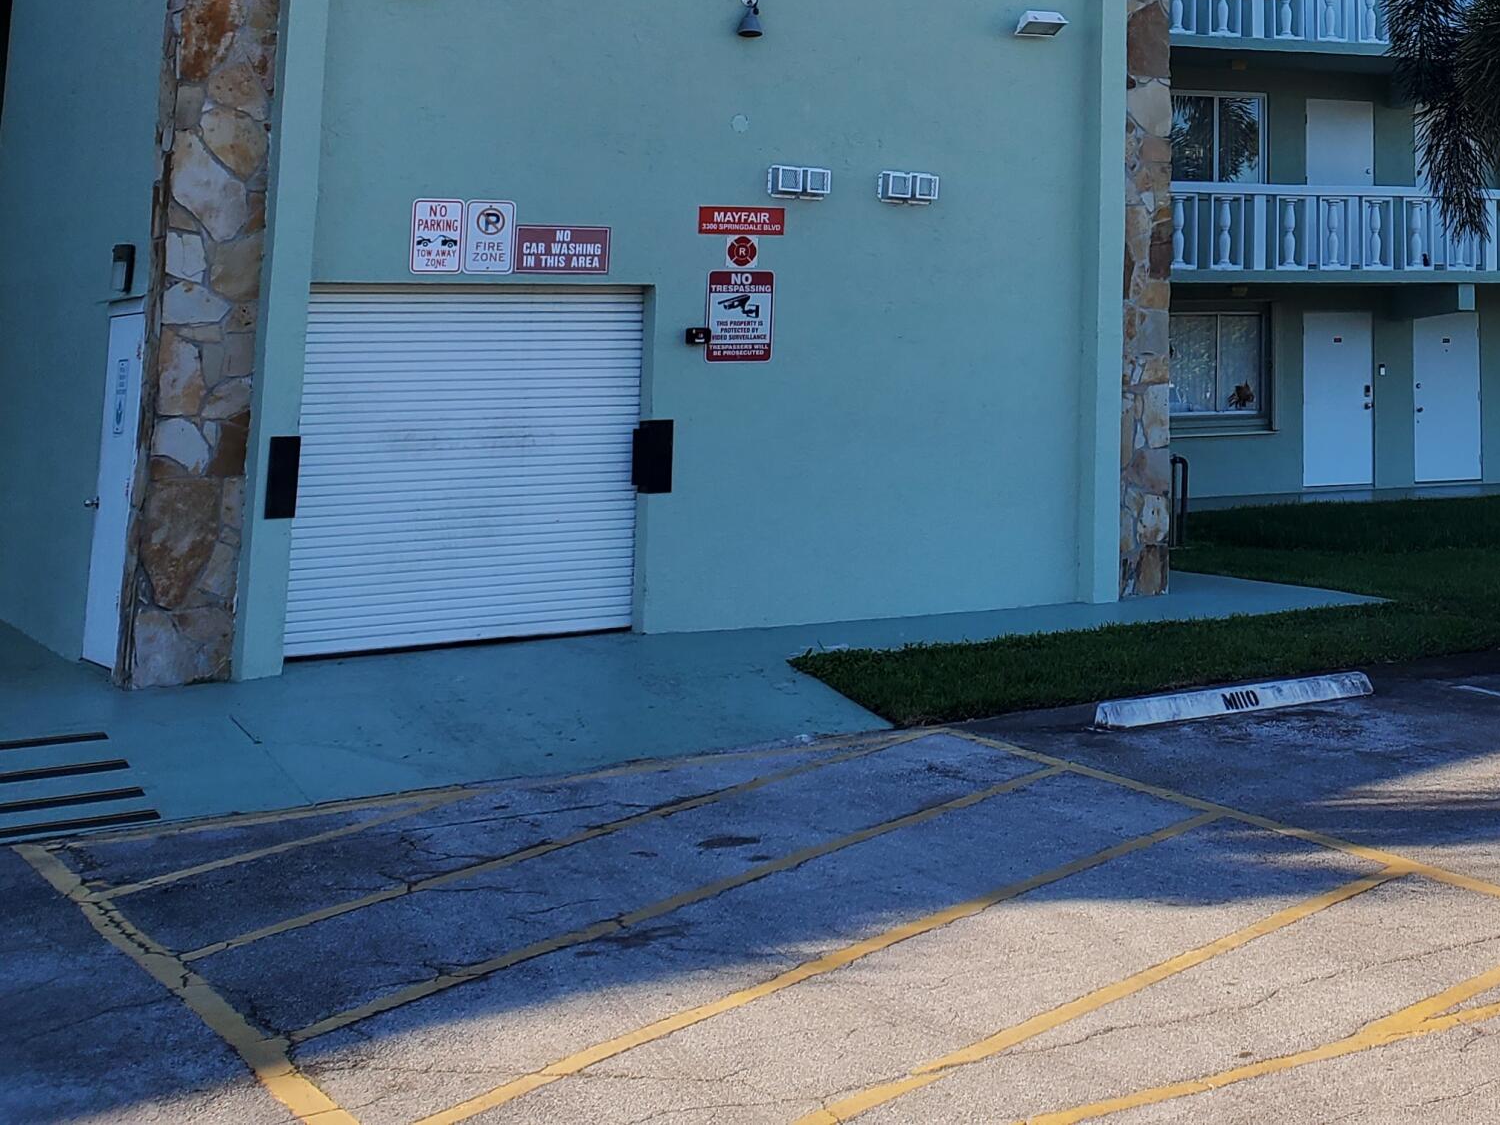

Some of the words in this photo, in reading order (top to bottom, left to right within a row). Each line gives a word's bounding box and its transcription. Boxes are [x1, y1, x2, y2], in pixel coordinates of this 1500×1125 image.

[429, 204, 448, 218] NO
[713, 211, 770, 223] MAYFAIR
[417, 218, 459, 232] PARKING
[719, 223, 762, 231] SPRINGDALE
[555, 229, 571, 242] NO
[475, 241, 504, 252] FIRE
[522, 242, 546, 254] CAR
[550, 242, 602, 255] WASHING
[738, 247, 747, 256] R
[416, 249, 433, 258] TOW
[435, 249, 457, 258] AWAY
[472, 252, 506, 263] ZONE
[425, 258, 447, 267] ZONE
[522, 255, 535, 267] IN
[540, 255, 566, 267] THIS
[570, 256, 600, 268] AREA
[731, 273, 753, 285] NO
[711, 284, 772, 293] TRESPASSING
